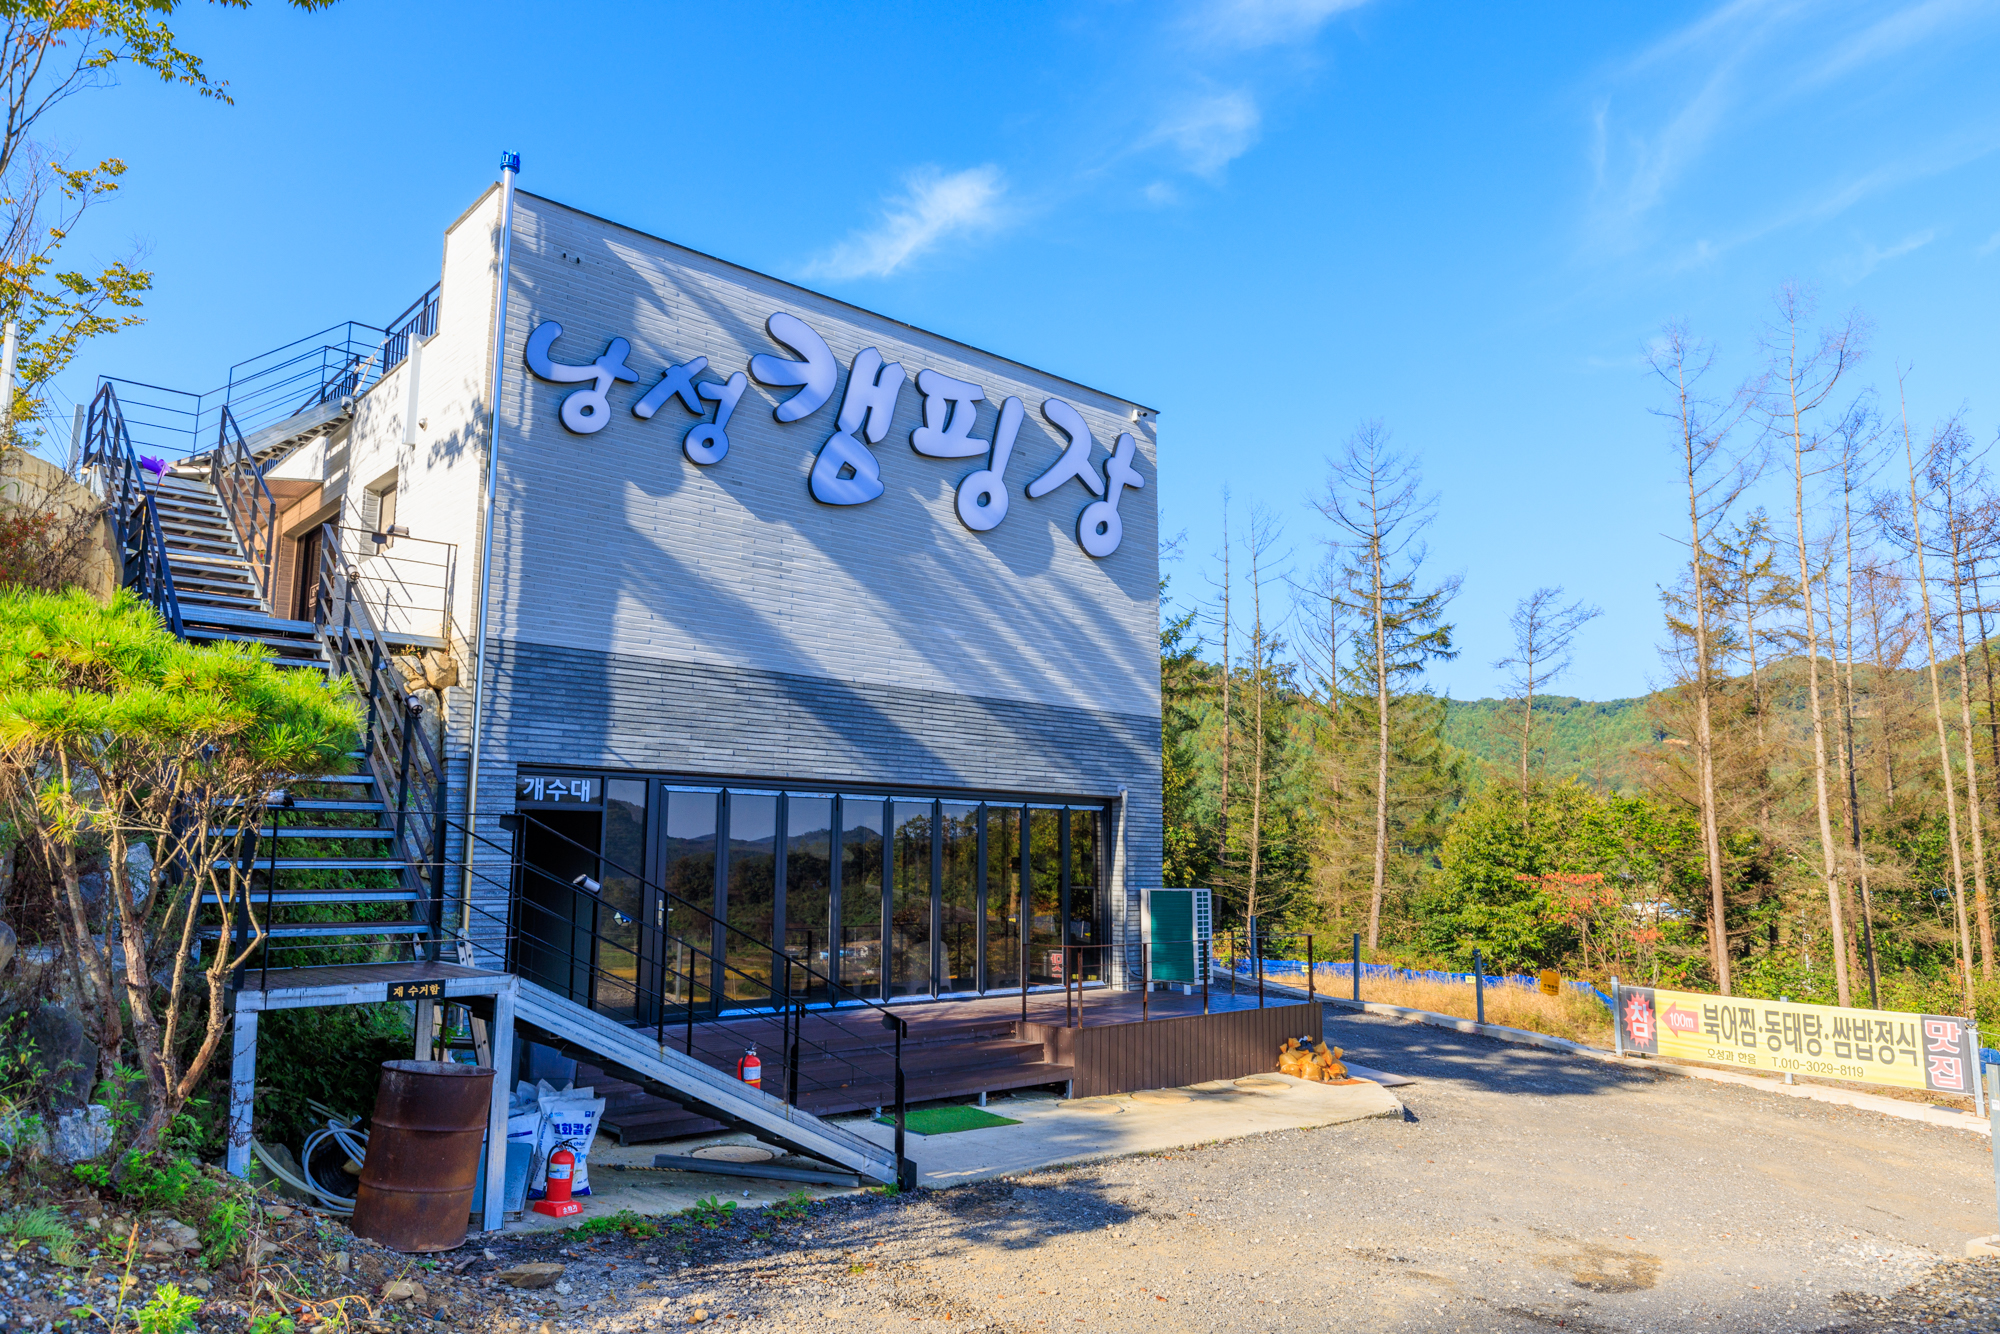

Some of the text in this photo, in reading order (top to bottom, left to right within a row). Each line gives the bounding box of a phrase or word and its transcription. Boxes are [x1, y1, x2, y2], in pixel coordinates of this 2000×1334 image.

[523, 777, 591, 803] 개수대
[393, 983, 440, 998] 재 수거함
[1630, 1002, 1649, 1038] 참
[1669, 1012, 1694, 1029] 100m
[1707, 1048, 1734, 1062] 오성과
[1924, 1019, 1965, 1090] 맛집
[1771, 1056, 1864, 1078] T.010-3029-8119
